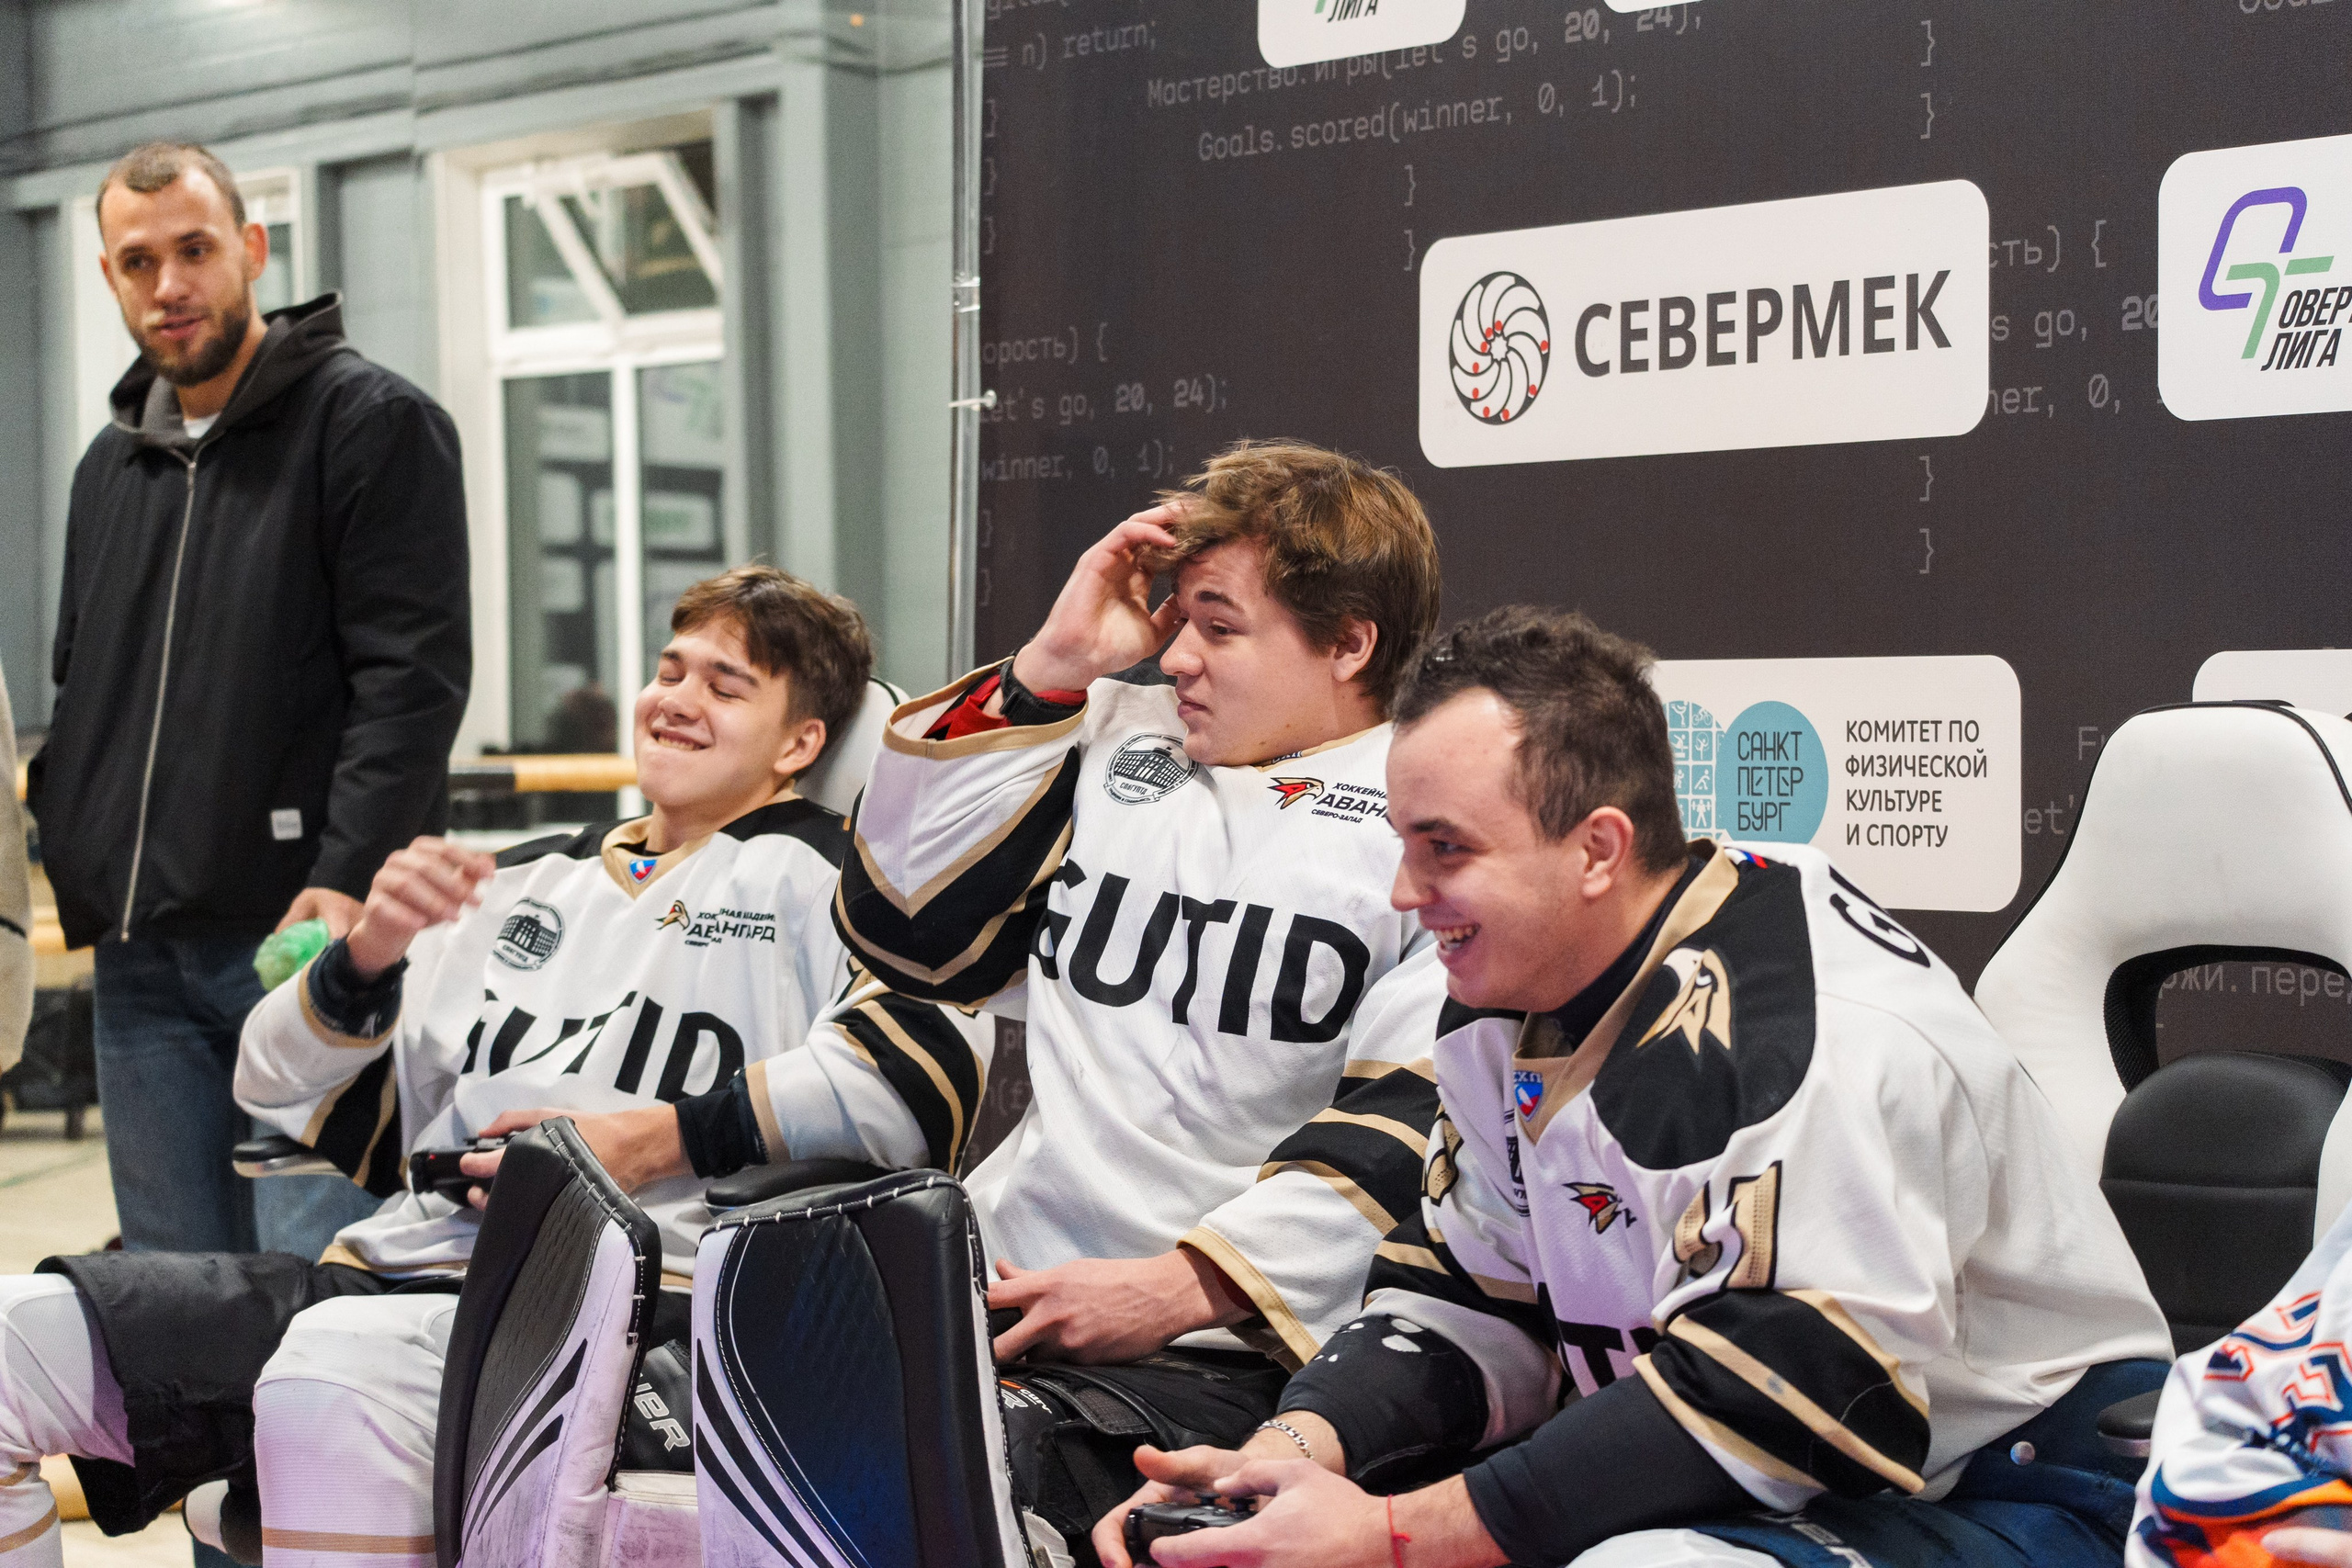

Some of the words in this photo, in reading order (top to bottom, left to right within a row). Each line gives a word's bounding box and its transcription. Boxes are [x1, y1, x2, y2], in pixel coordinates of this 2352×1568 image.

[1565, 8, 1610, 44] 20,
[2278, 286, 2352, 329] ОВЕР
[1575, 269, 1952, 378] СЕВЕРМЕК
[2033, 309, 2087, 349] go,
[2260, 328, 2343, 371] ЛИГА
[1737, 731, 1803, 761] САНКТ
[1845, 719, 1942, 743] КОМИТЕТ
[1948, 719, 1981, 743] ПО
[1845, 748, 1987, 778] ФИЗИЧЕСКОЙ
[1737, 766, 1804, 797] ПЕТЕР
[1316, 793, 1388, 818] АВАН
[1845, 789, 1942, 812] КУЛЬТУРЕ
[1737, 801, 1792, 832] БУРГ
[1846, 823, 1860, 846] И
[1866, 823, 1949, 848] СПОРТУ
